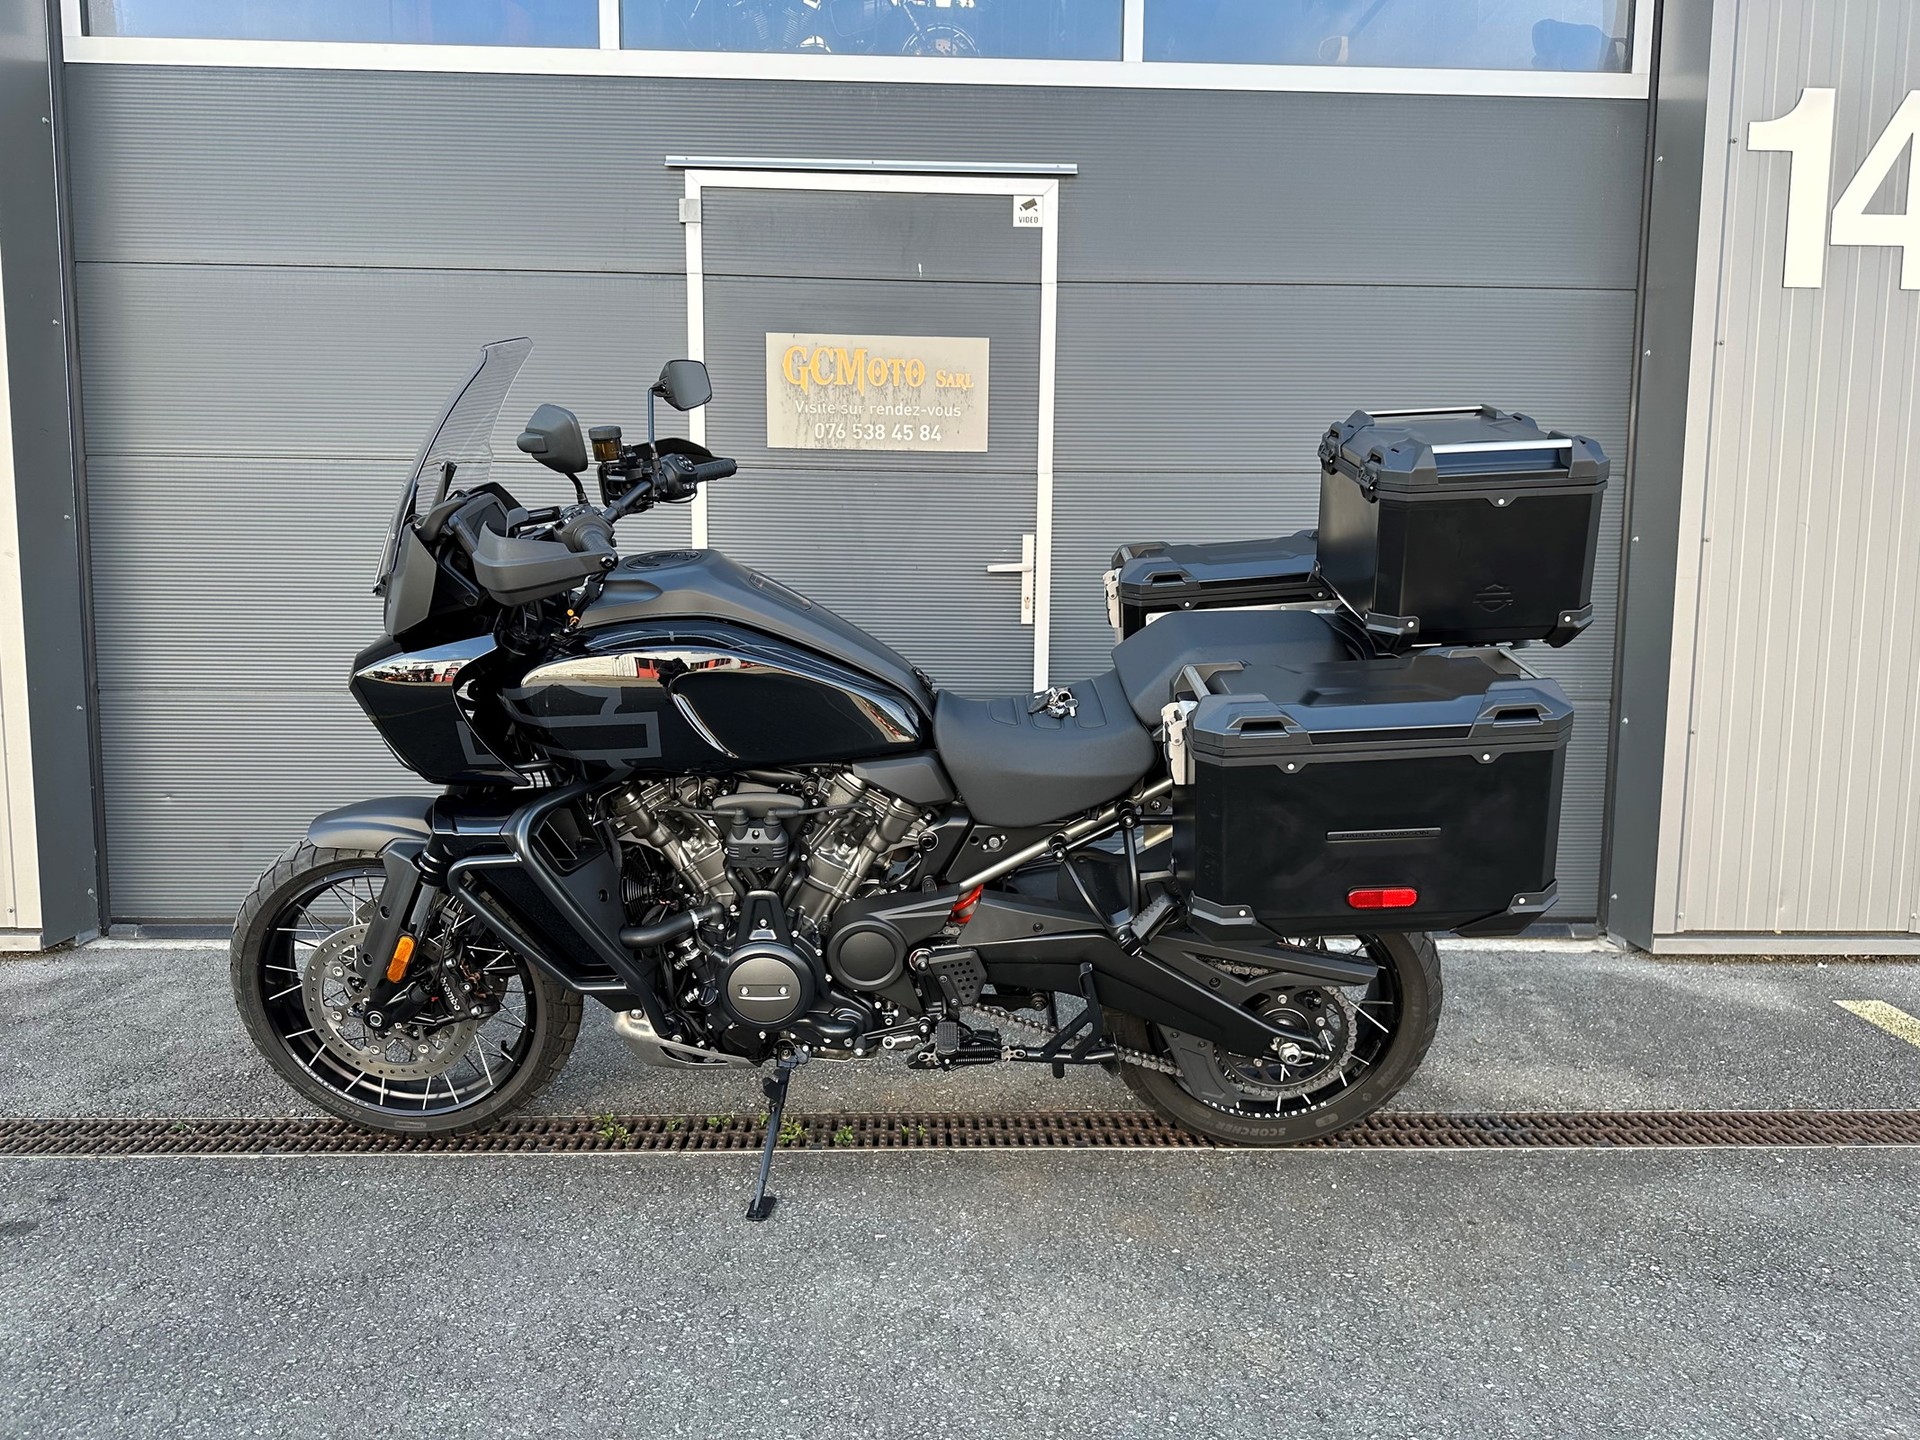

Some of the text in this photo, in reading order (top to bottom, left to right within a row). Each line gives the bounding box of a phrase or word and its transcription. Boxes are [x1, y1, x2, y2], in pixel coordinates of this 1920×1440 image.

[1747, 87, 1920, 291] 14
[1018, 216, 1039, 224] VIDEO
[795, 400, 961, 417] Visite sur rendez-vous
[814, 422, 942, 441] 076 538 45 84
[440, 976, 461, 1011] brembo
[1215, 1120, 1287, 1137] SCORCHER
